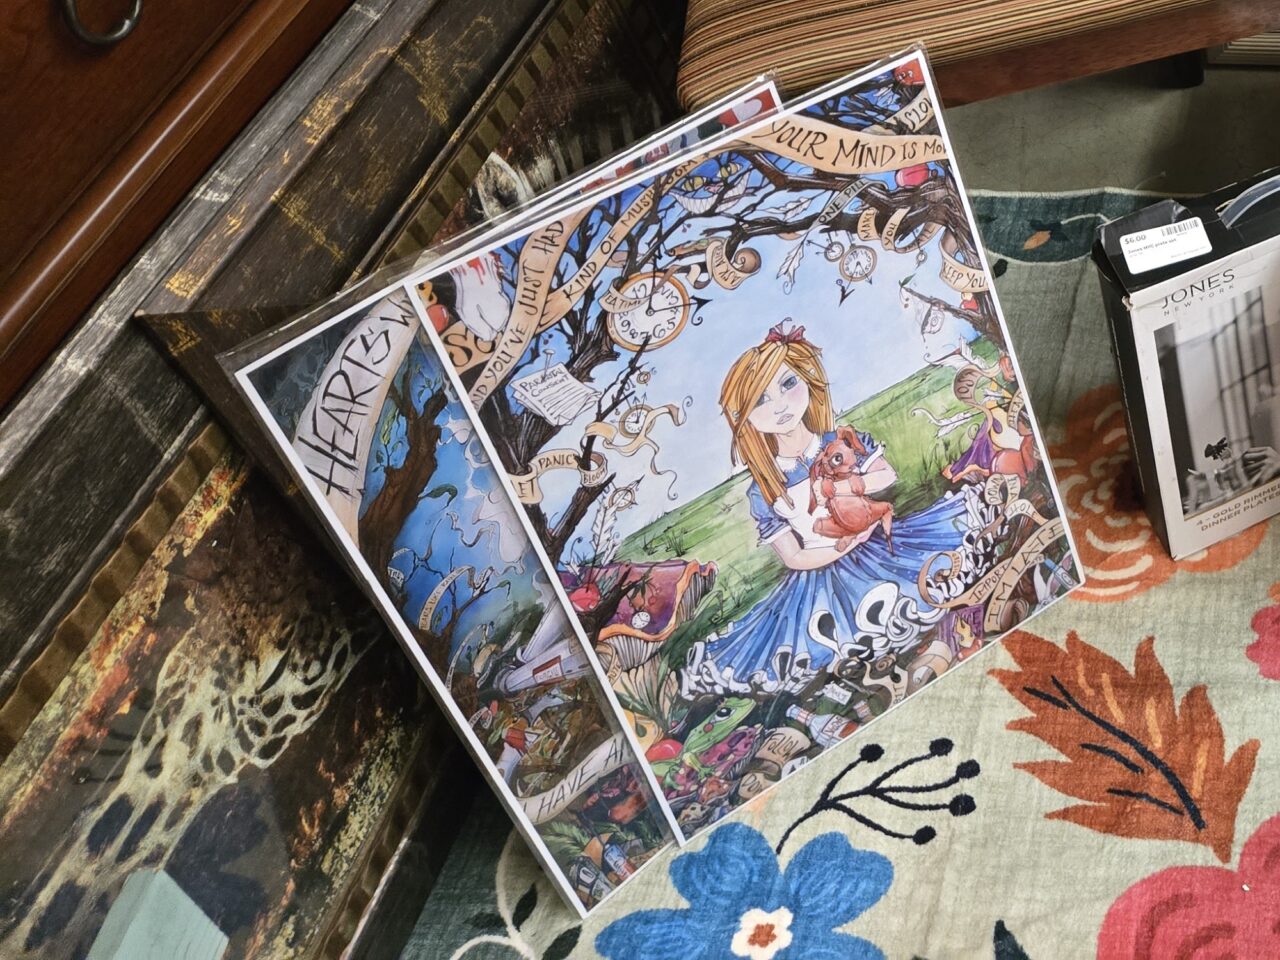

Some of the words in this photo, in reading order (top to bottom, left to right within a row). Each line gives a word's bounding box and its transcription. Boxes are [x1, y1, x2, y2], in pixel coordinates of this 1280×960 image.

[752, 120, 828, 160] YOUR
[832, 139, 896, 169] MIND
[900, 141, 917, 162] IS
[818, 199, 841, 224] ONE
[531, 220, 565, 255] HAD
[884, 223, 898, 245] YOU
[1124, 234, 1147, 245] $6.00
[563, 261, 597, 302] KIND
[601, 233, 618, 255] OF
[942, 261, 964, 281] KEEP
[518, 259, 545, 315] JUST
[1162, 268, 1235, 309] JONES
[1164, 302, 1192, 316] NEW
[1199, 285, 1235, 302] YORK
[485, 321, 526, 382] YOU'VE
[298, 327, 391, 499] HEARTS
[538, 453, 574, 469] PANIC
[1201, 511, 1241, 531] DINNER
[1213, 503, 1241, 519] GOLD
[537, 759, 596, 821] HAVE
